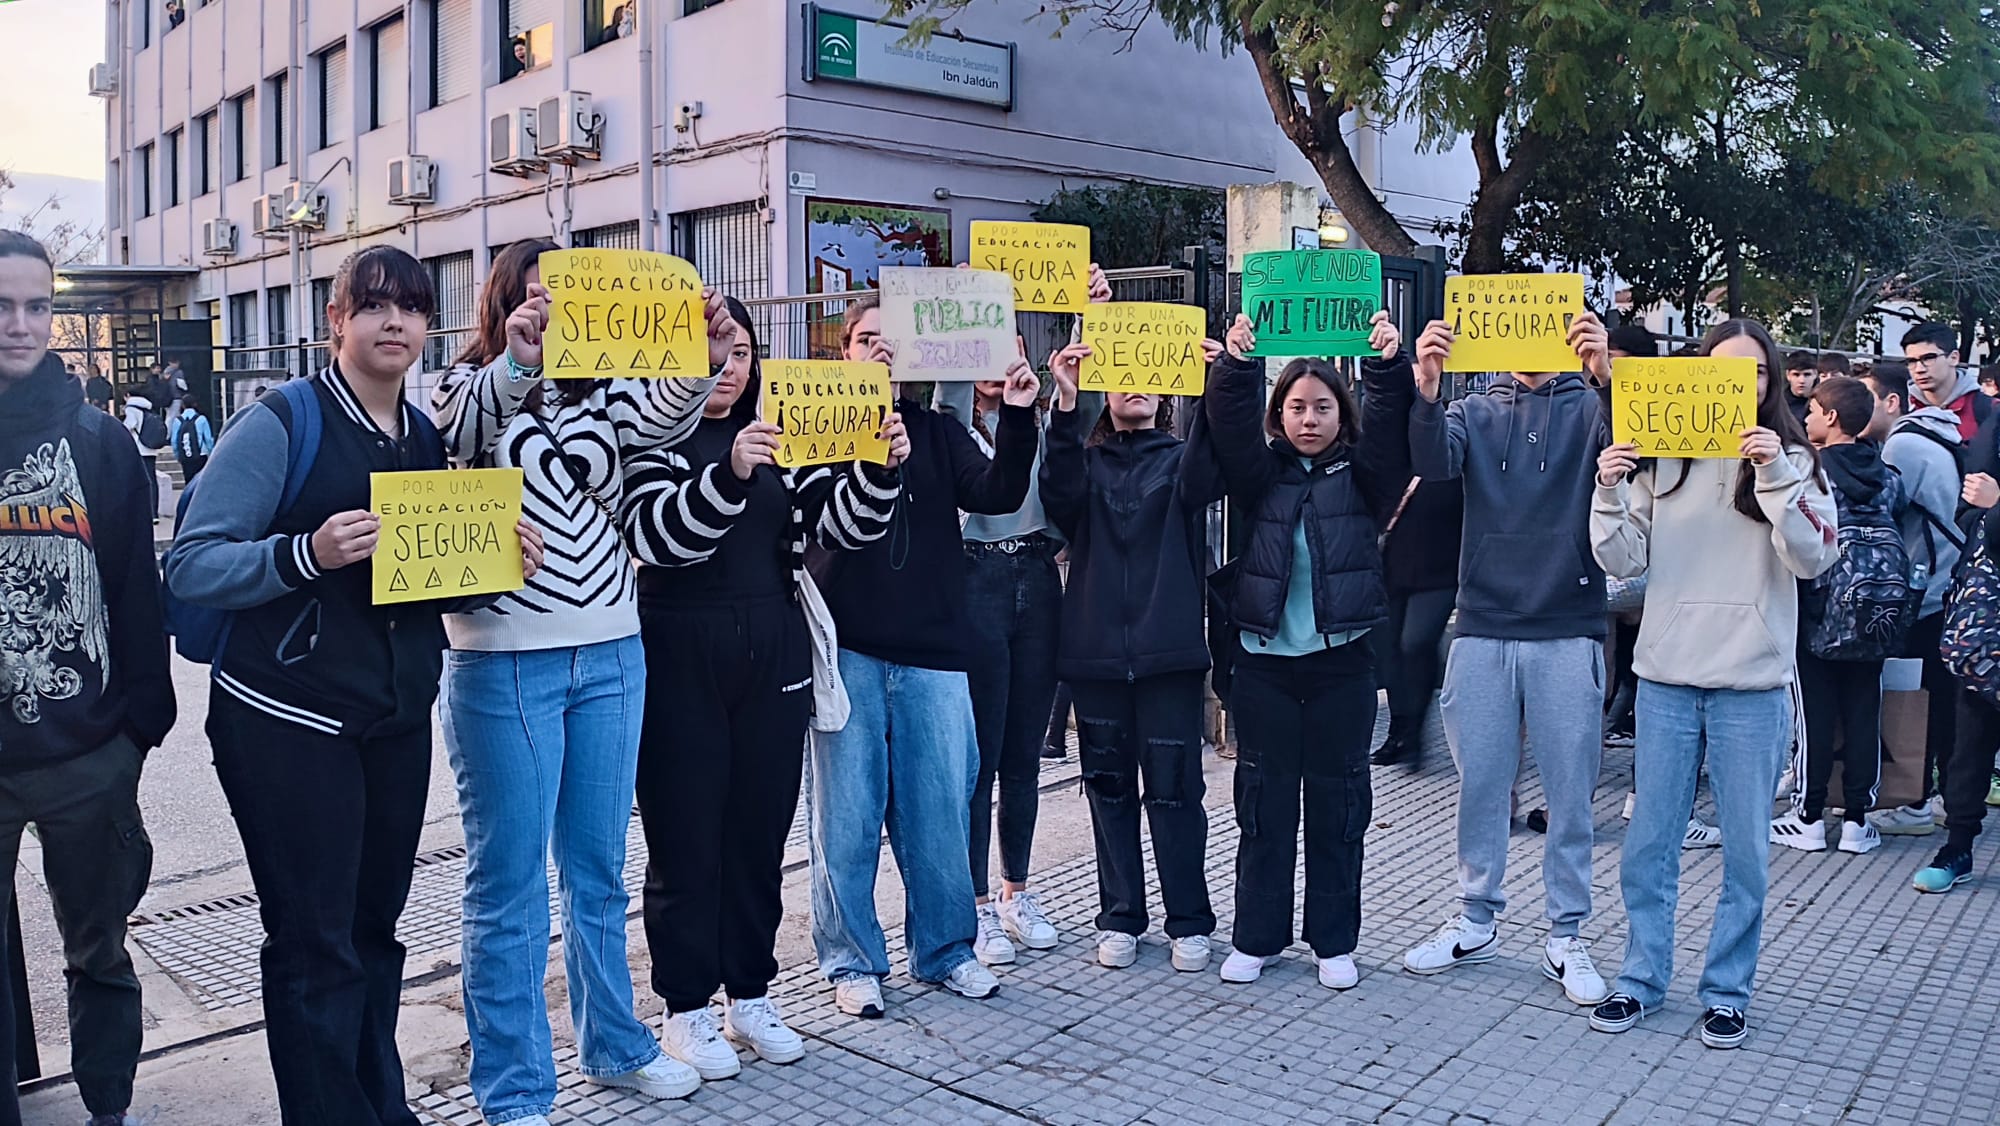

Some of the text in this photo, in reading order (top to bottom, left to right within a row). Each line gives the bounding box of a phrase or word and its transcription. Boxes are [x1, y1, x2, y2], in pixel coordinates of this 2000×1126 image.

[915, 50, 925, 60] de
[926, 50, 961, 66] Educación
[942, 69, 999, 89] Ibn Jaldún
[977, 237, 1076, 249] EDUCACIÓN
[570, 255, 664, 273] POR UNA
[1245, 251, 1376, 288] SE VENDE
[547, 274, 694, 292] EDUCACIÓN
[1468, 278, 1531, 291] POR UNA
[1451, 290, 1569, 304] EDUCACIÓN
[1105, 305, 1175, 321] POR UNA
[1253, 297, 1375, 335] MI FUTURO
[561, 299, 693, 344] SEGURA
[1087, 320, 1198, 336] EDUCACIÓN
[1093, 337, 1196, 368] SEGURA
[785, 365, 845, 380] POR UNA
[1636, 363, 1718, 377] POR UNA
[770, 379, 879, 397] EDUCACIÓN
[1620, 378, 1744, 395] EDUCACIÓN
[1627, 399, 1746, 436] SEGURA
[1528, 432, 1536, 443] S
[403, 480, 484, 495] POR UNA
[381, 499, 506, 515] EDUCACIÓN
[394, 521, 501, 562] SEGURA
